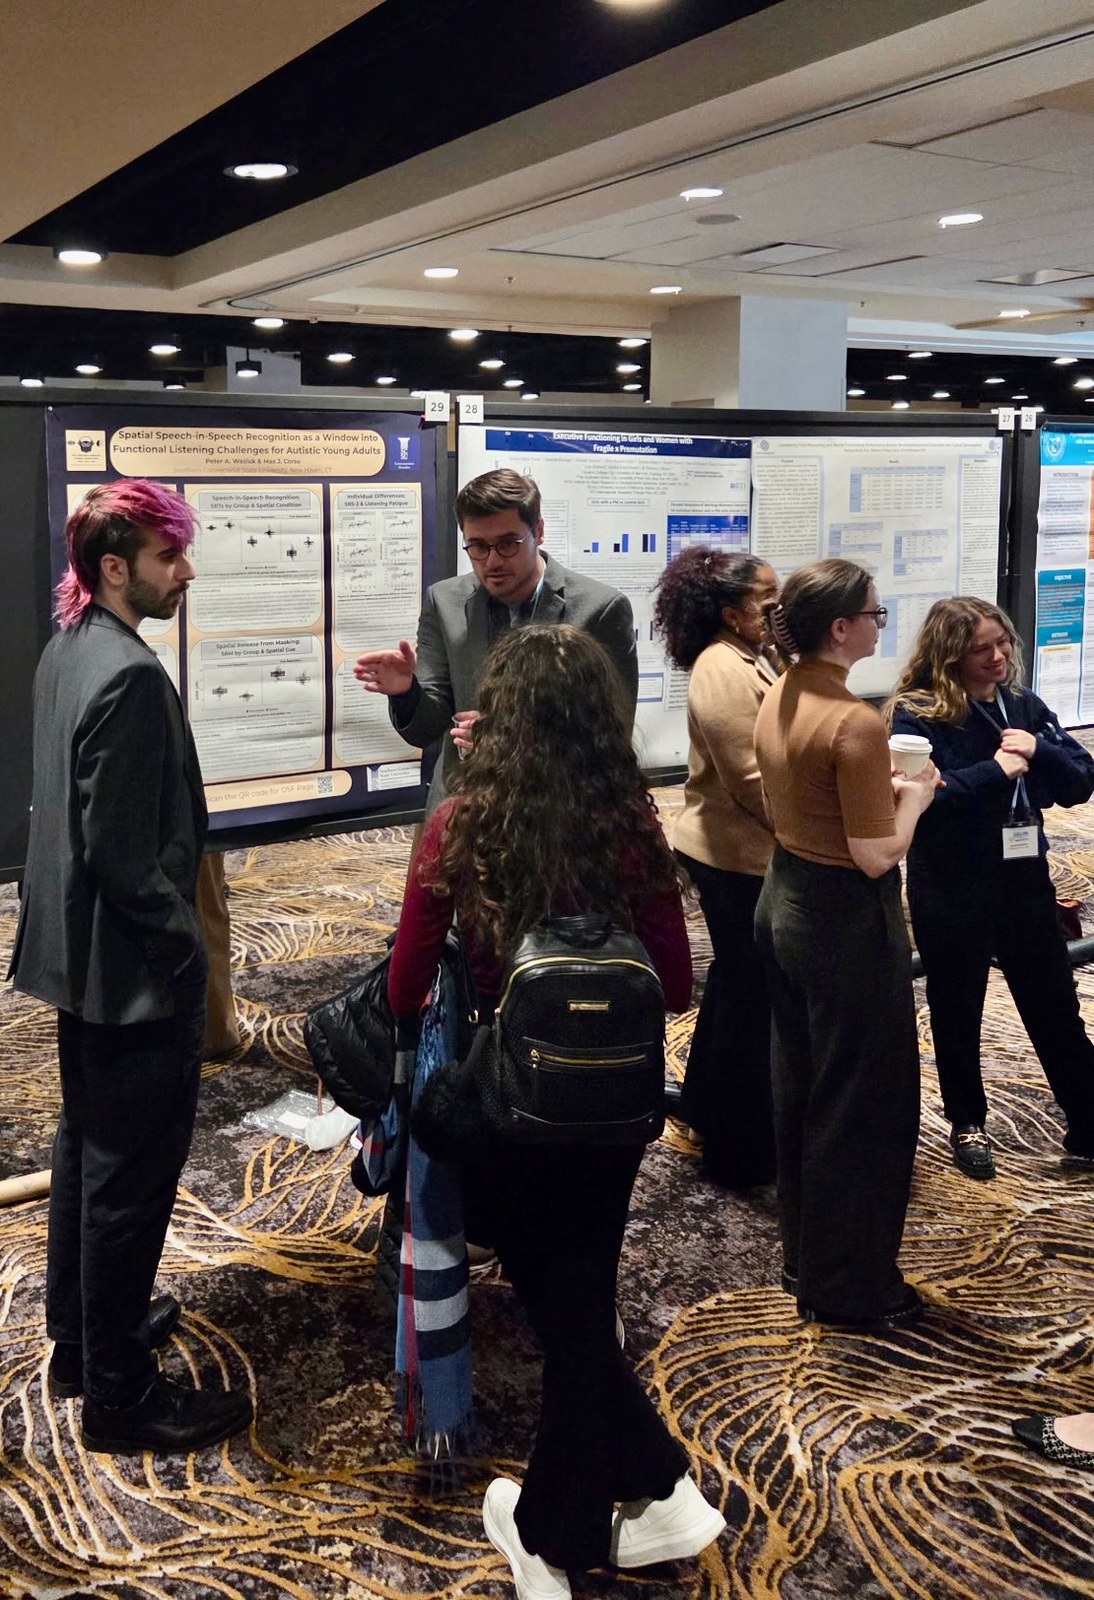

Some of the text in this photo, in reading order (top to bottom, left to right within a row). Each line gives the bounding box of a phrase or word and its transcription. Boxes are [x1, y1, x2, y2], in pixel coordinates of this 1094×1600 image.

[430, 402, 444, 412] 29
[465, 404, 478, 414] 28
[1002, 414, 1011, 423] 27
[1024, 414, 1033, 423] 26
[118, 430, 153, 440] Spatial
[155, 431, 243, 442] Speech-in-Speech
[245, 432, 301, 443] Recognition
[303, 434, 313, 442] as
[322, 433, 359, 442] Window
[361, 433, 378, 442] into
[552, 432, 583, 441] Executive
[584, 433, 621, 443] Functioning
[621, 434, 628, 443] in
[643, 435, 655, 443] and
[656, 435, 679, 444] Women
[679, 436, 694, 445] with
[113, 444, 381, 456] Functional Listening Challenges for Autistic Young Adults
[592, 443, 614, 454] Fragile
[620, 444, 658, 454] Premutation
